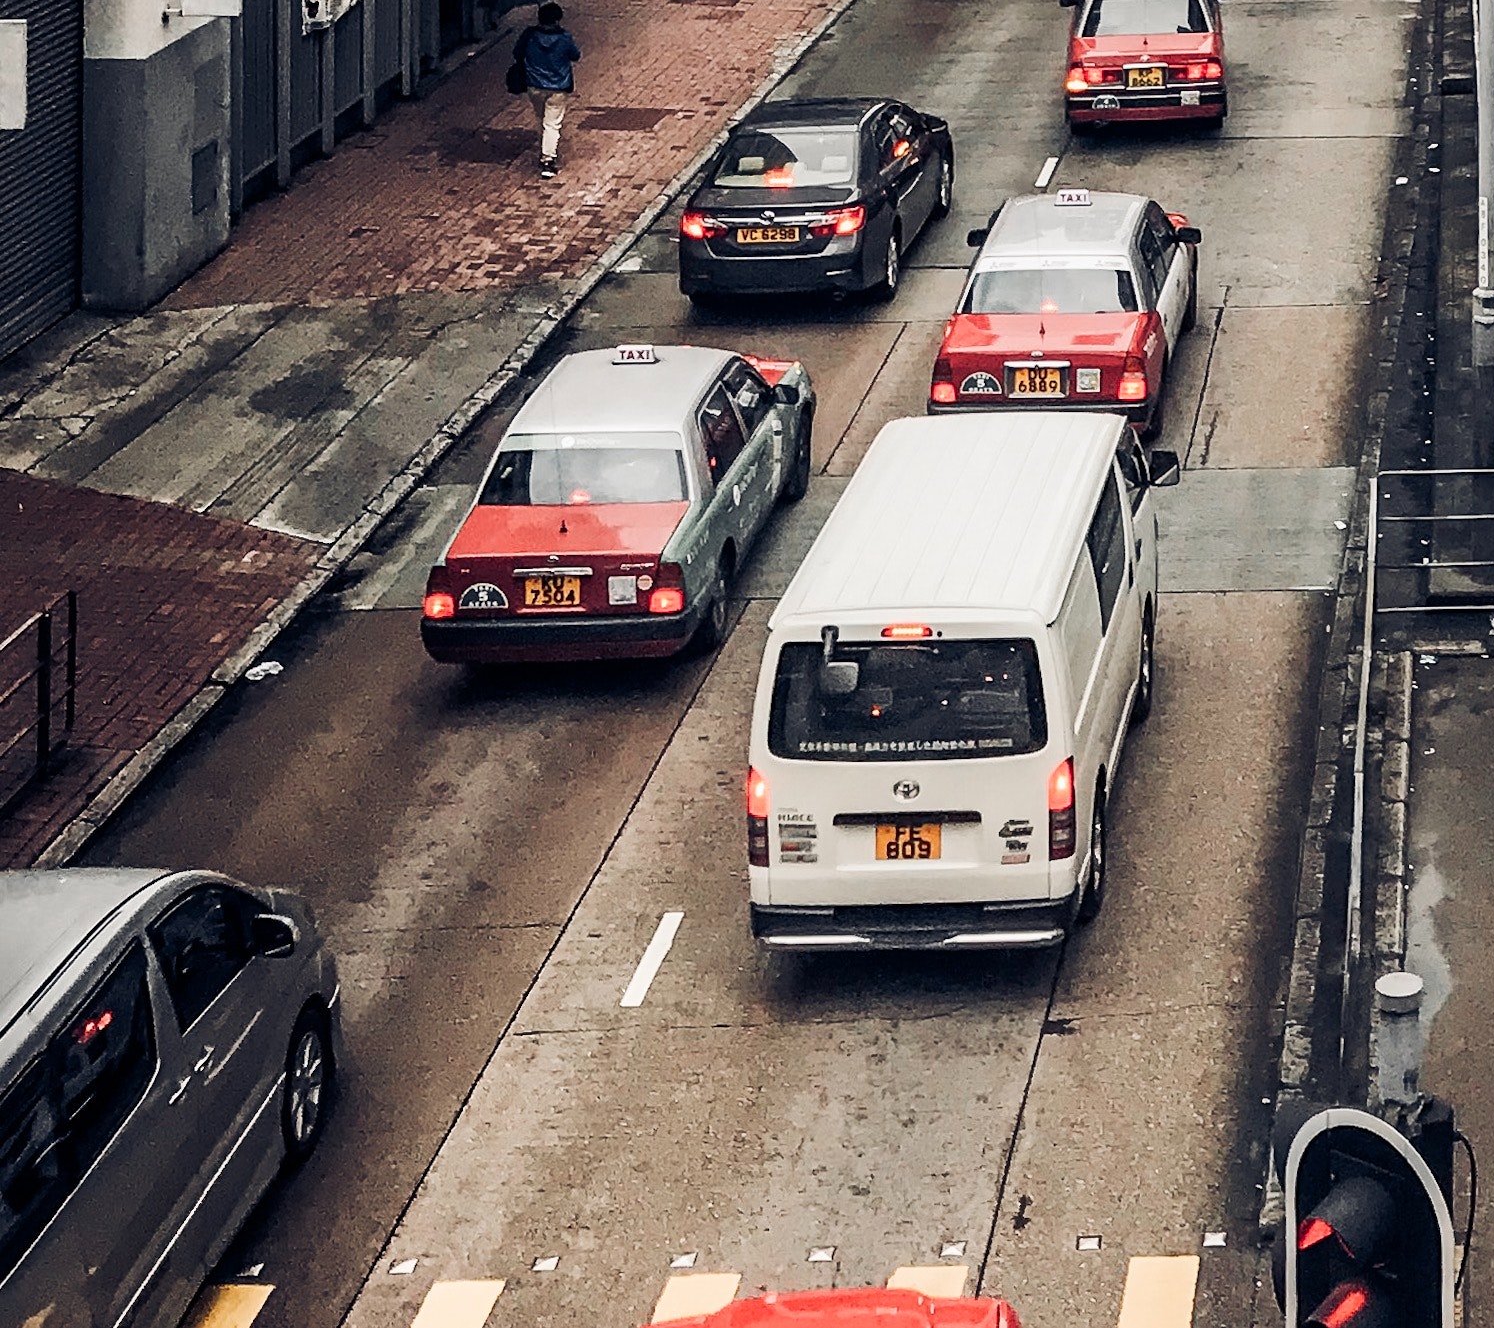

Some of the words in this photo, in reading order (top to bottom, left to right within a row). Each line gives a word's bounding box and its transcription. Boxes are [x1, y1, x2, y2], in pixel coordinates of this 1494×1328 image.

[1059, 193, 1088, 203] TAXI
[741, 229, 758, 241] VC
[762, 229, 796, 241] 6298
[618, 349, 651, 361] TAXI
[1018, 379, 1058, 393] 6889
[530, 589, 576, 605] 7504
[894, 824, 923, 842] FE
[885, 841, 932, 860] 809
